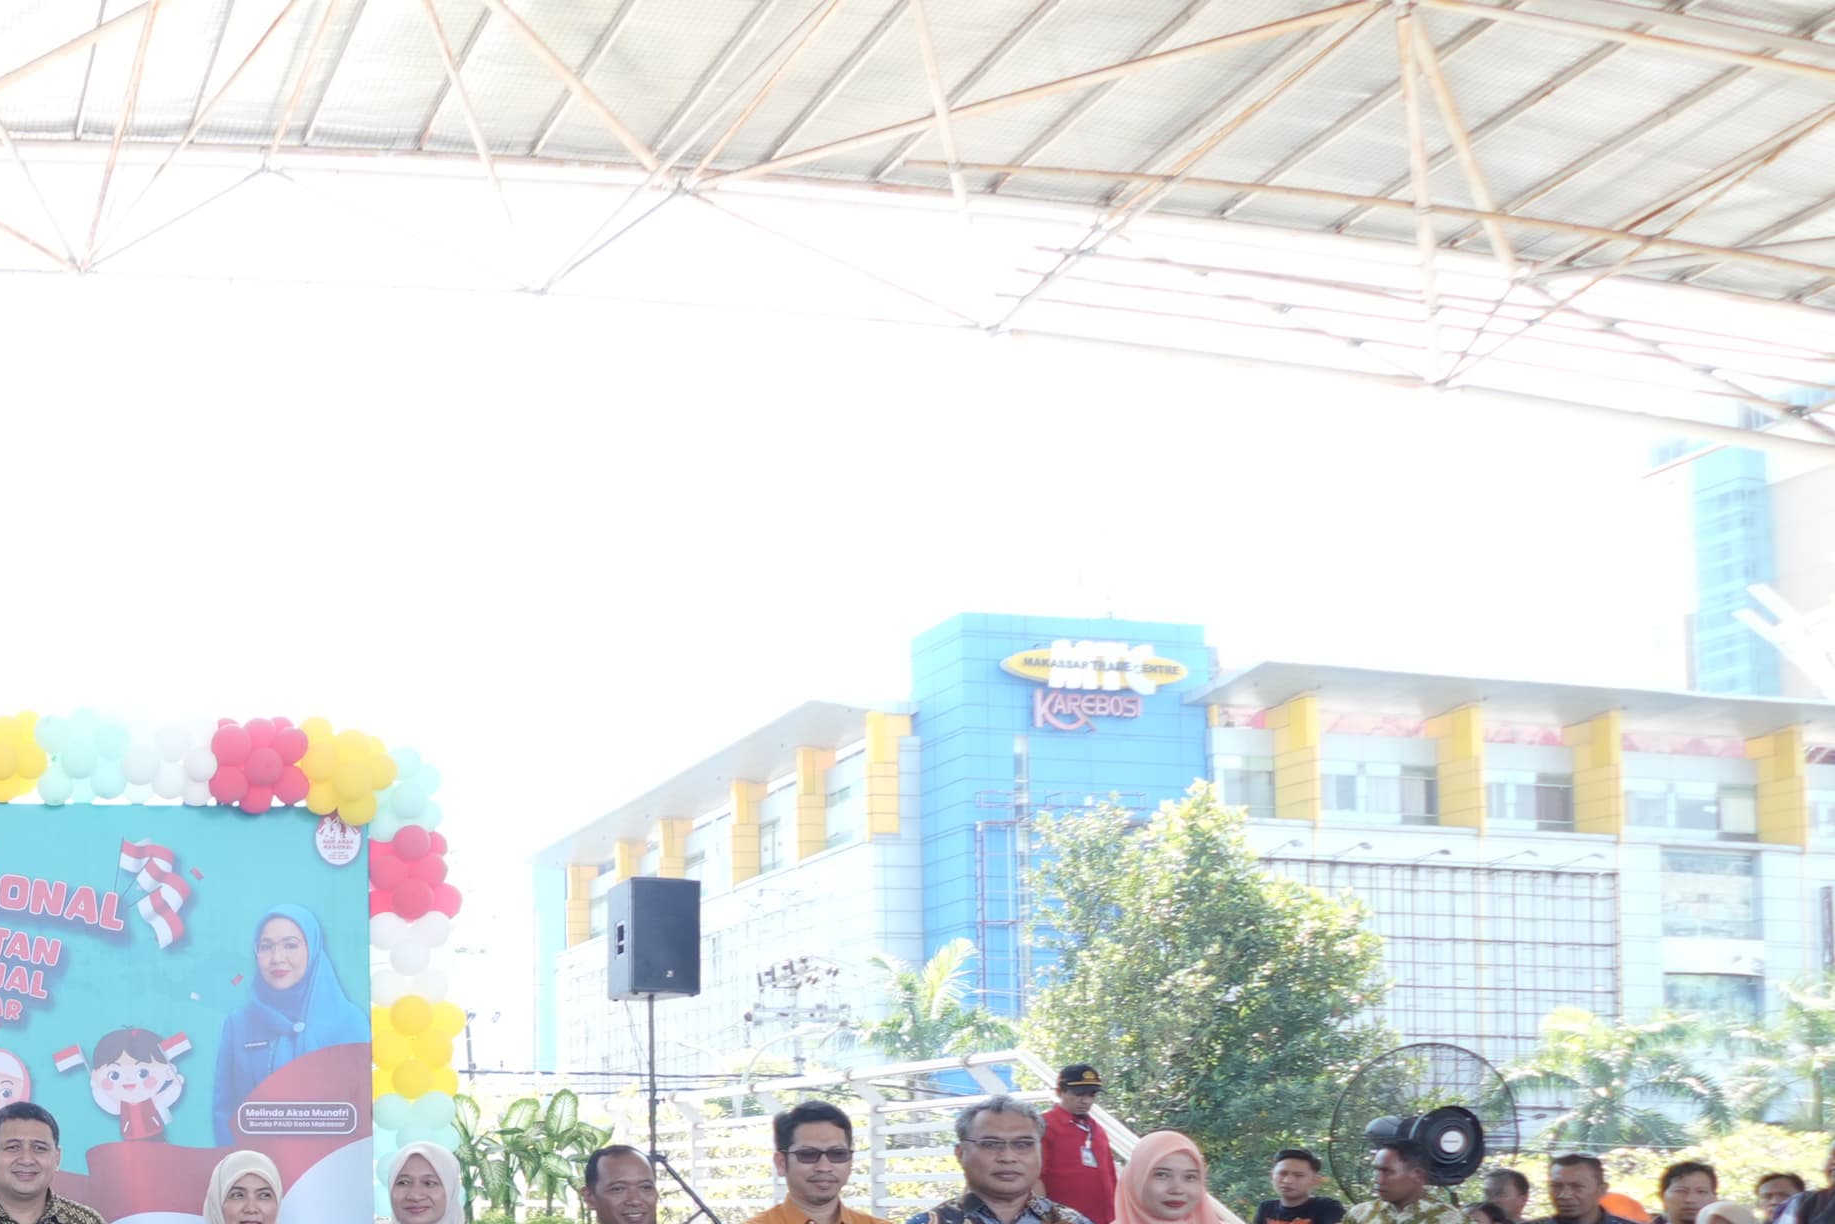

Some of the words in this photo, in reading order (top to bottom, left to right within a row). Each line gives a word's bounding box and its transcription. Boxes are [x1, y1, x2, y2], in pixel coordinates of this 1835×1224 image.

[1033, 689, 1142, 732] KAREBOSI
[246, 1108, 284, 1117] Melinda
[286, 1108, 310, 1117] Aksa
[312, 1108, 349, 1117] Munafri
[274, 1120, 292, 1128] PAUD
[293, 1120, 310, 1128] Kota
[312, 1120, 346, 1128] Makassar
